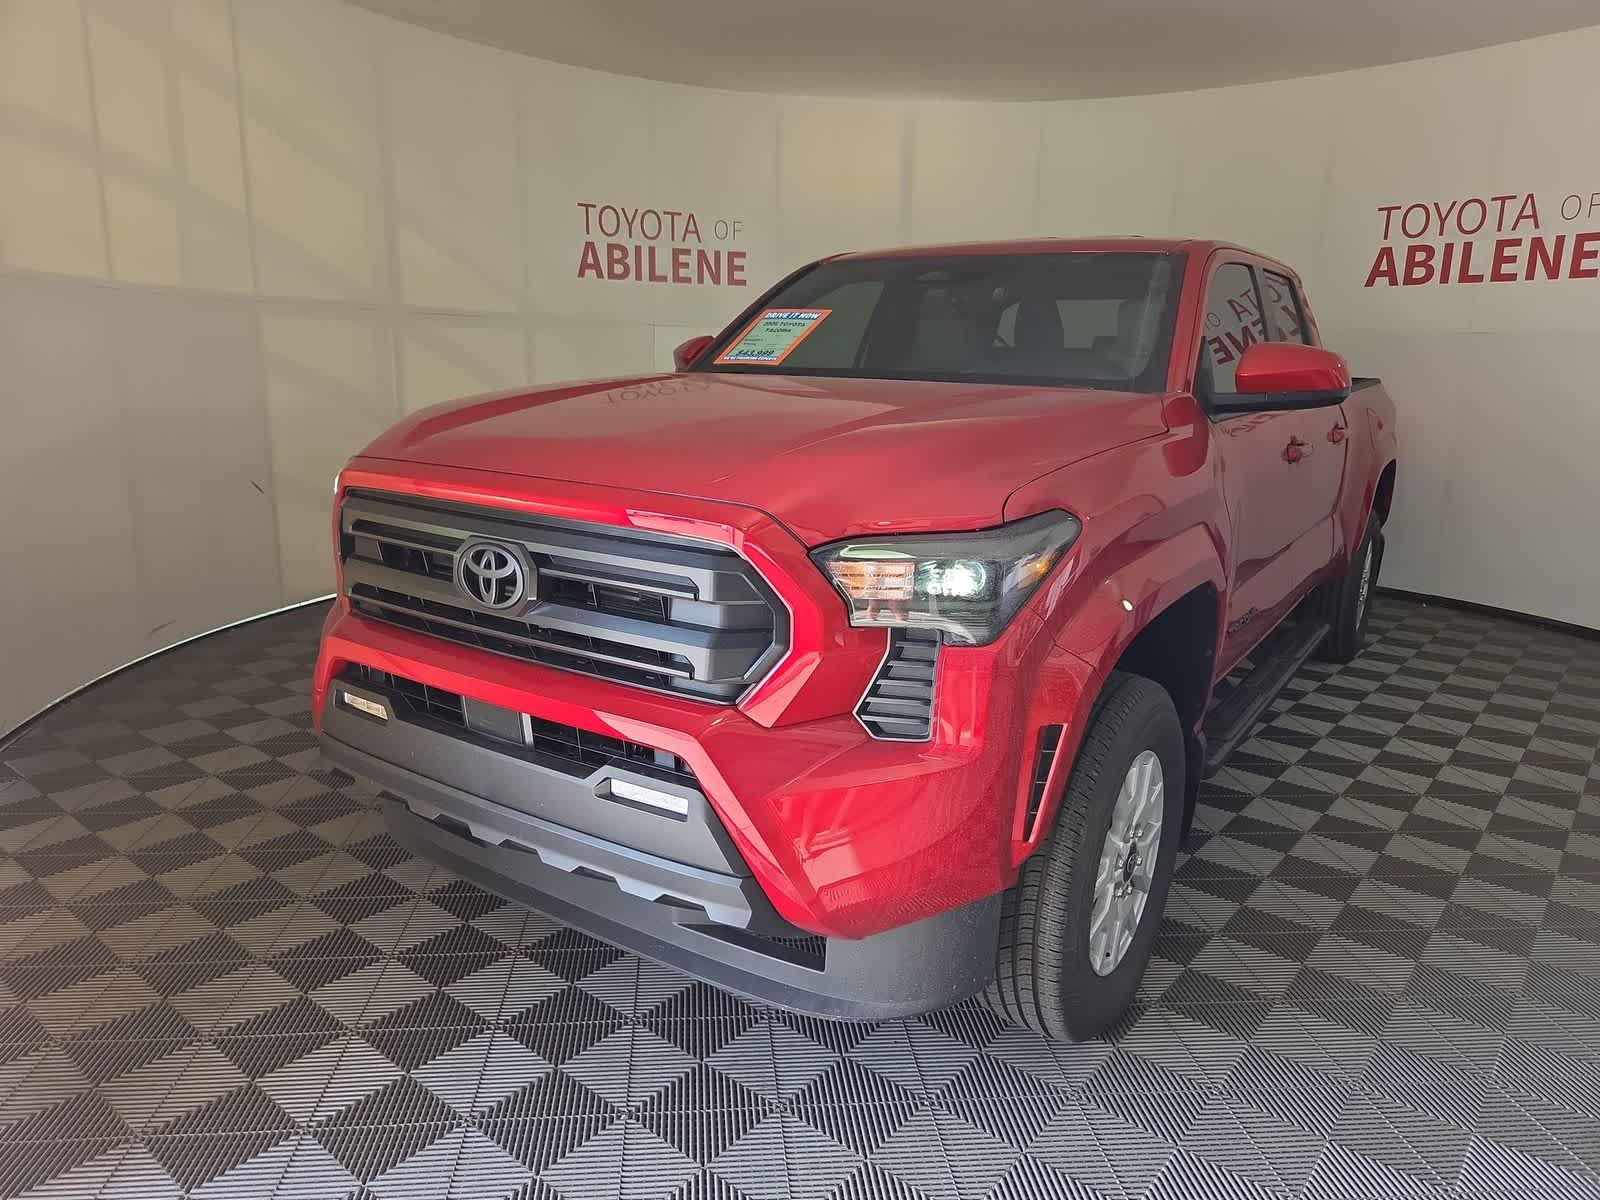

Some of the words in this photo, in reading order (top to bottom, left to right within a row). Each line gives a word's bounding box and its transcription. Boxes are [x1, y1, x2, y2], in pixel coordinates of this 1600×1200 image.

[577, 202, 702, 243] TOYOTA
[714, 219, 744, 241] OF
[1377, 193, 1540, 241] TOYOTA
[1560, 192, 1600, 221] OF
[577, 241, 748, 287] ABILENE
[1364, 232, 1600, 288] ABILENE
